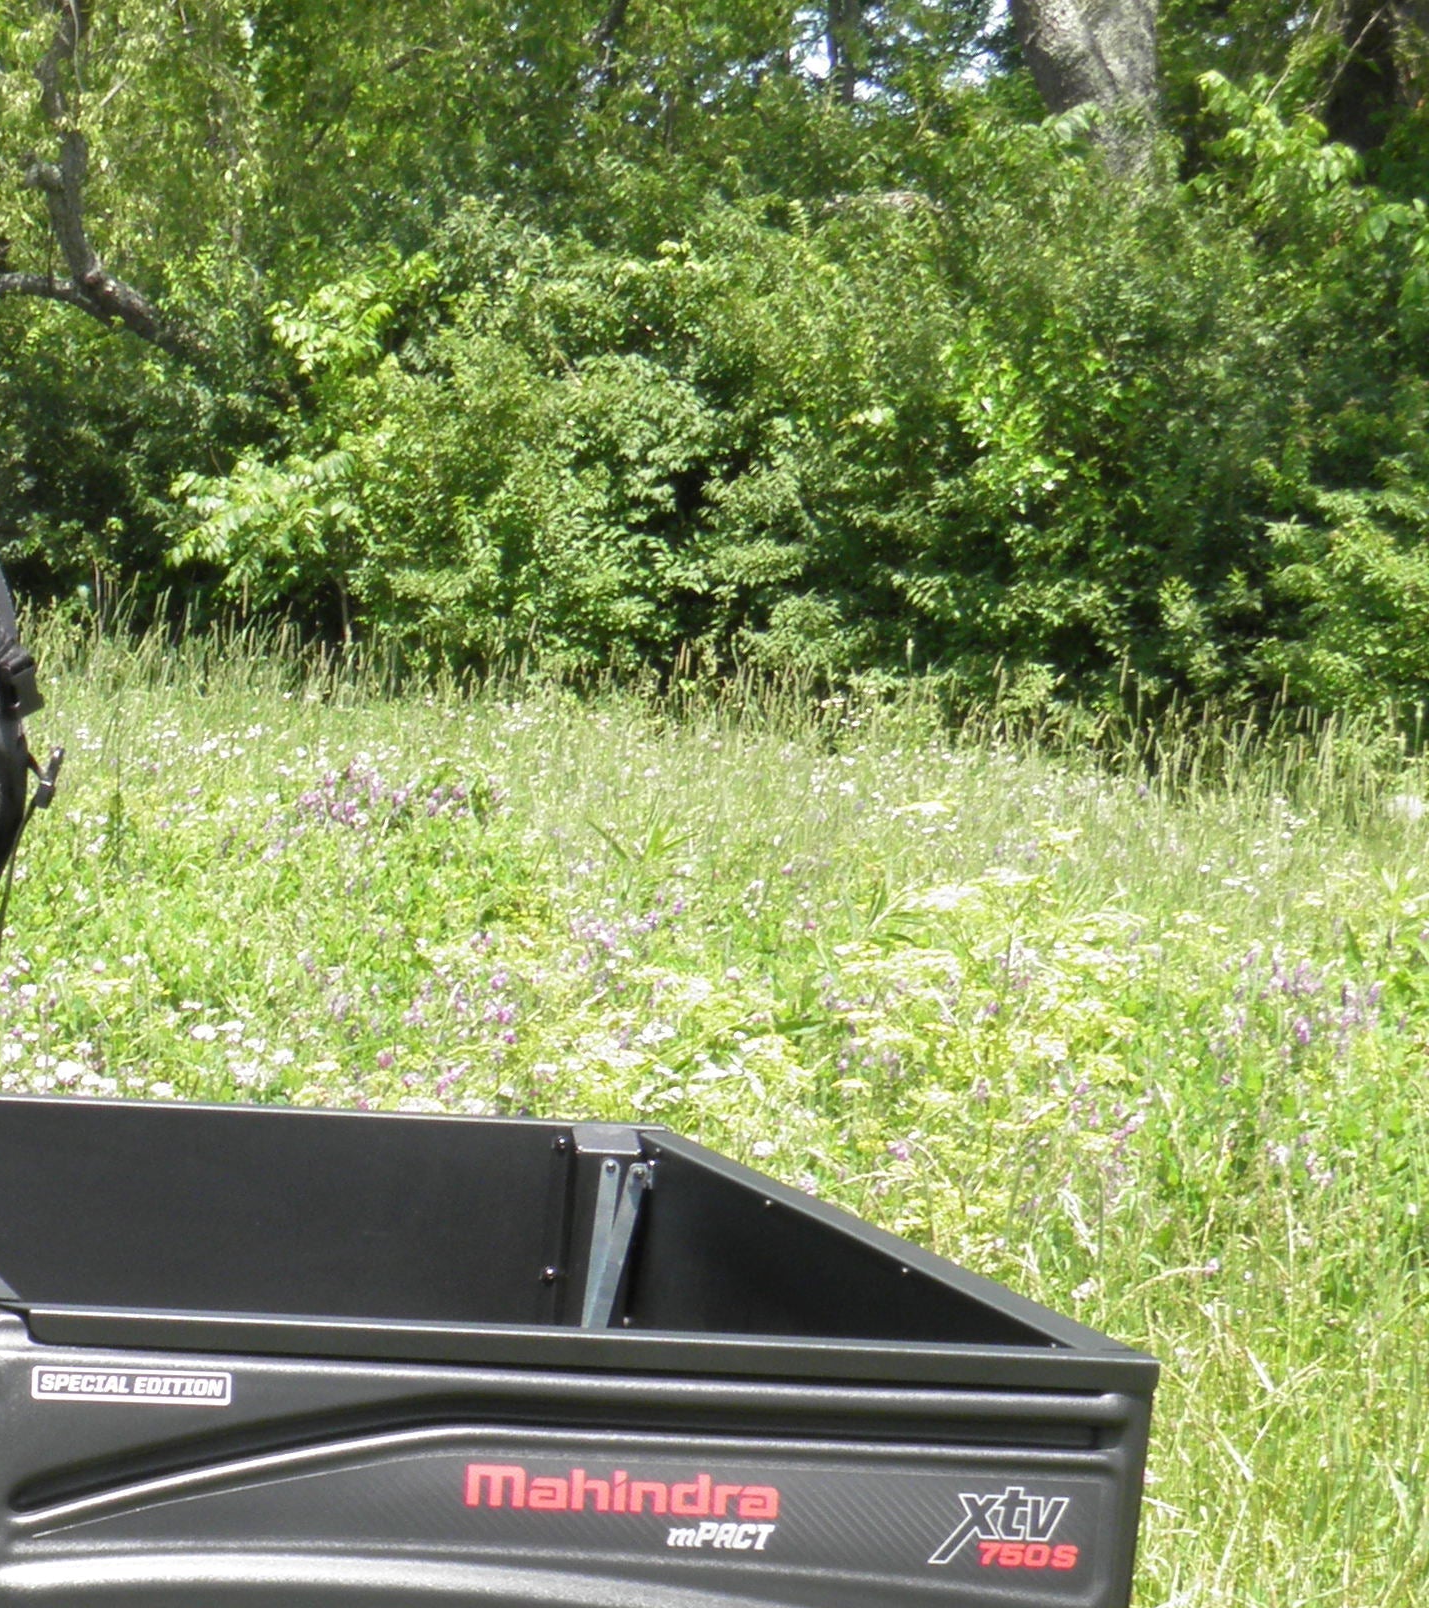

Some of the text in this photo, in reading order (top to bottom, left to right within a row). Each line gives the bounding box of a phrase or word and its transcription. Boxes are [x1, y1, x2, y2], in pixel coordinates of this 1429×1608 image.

[40, 1373, 224, 1397] SPECIAL EDITION
[464, 1463, 780, 1518] Mahindra
[667, 1521, 775, 1550] mPACT
[978, 1541, 1080, 1570] 750S
